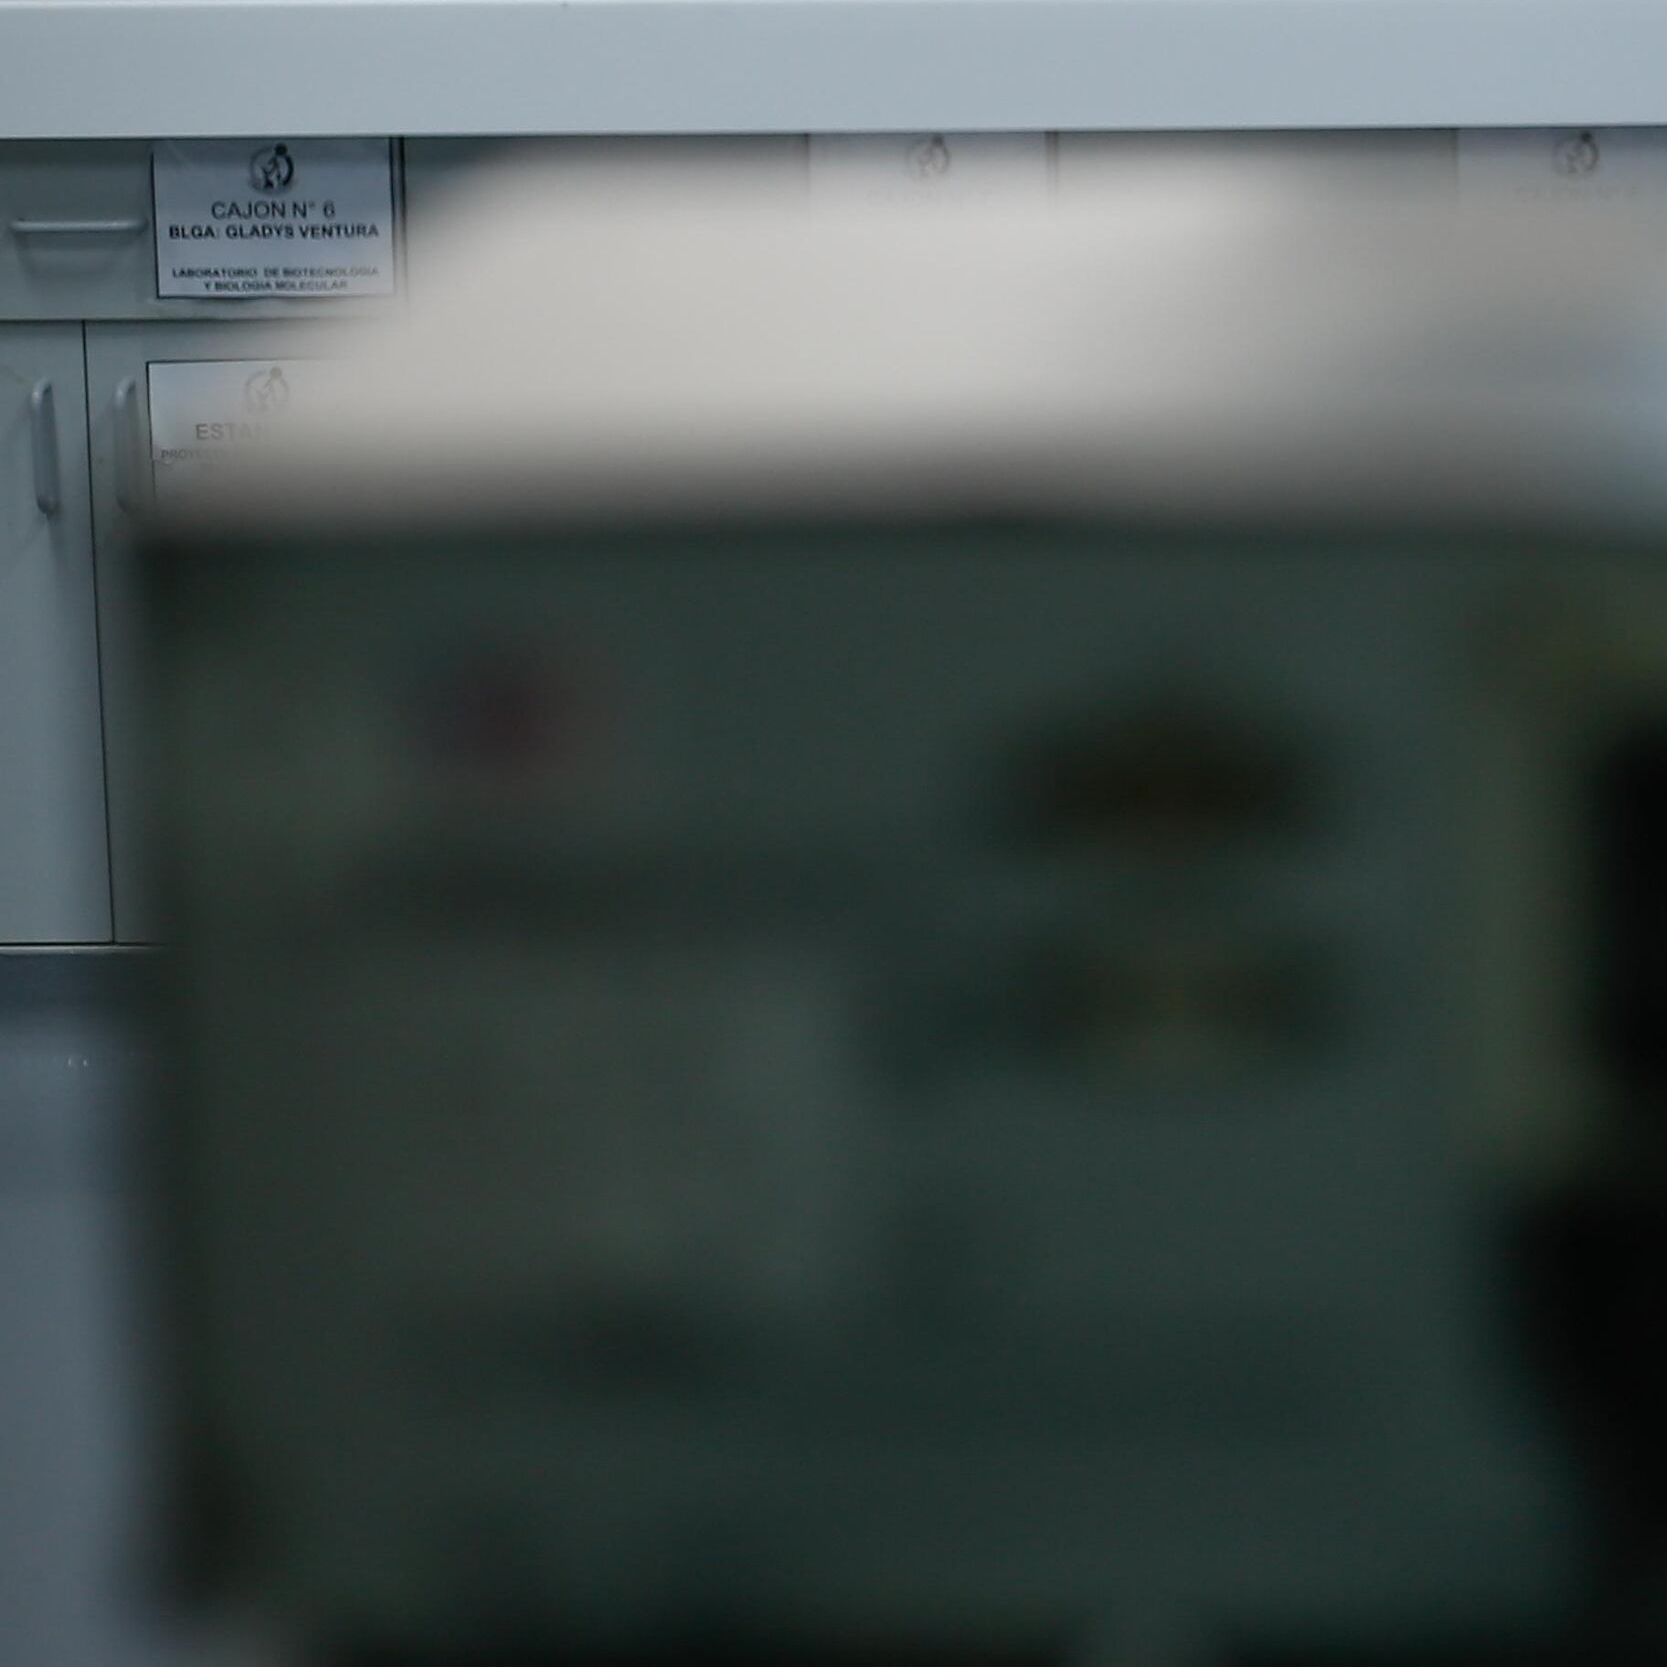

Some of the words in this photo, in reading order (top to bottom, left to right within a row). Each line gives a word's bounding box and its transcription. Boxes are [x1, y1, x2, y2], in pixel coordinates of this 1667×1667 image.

[210, 200, 286, 220] CAJON
[323, 200, 336, 219] 6
[225, 224, 294, 240] GLADYS
[299, 222, 380, 238] VENTURA
[172, 267, 258, 279] LABORATORIO
[264, 267, 280, 279] DE
[283, 266, 380, 279] BIOTECNOLOGIA
[204, 280, 213, 291] Y
[215, 280, 273, 292] BIOLOGIA
[275, 279, 349, 291] MOLECULAR
